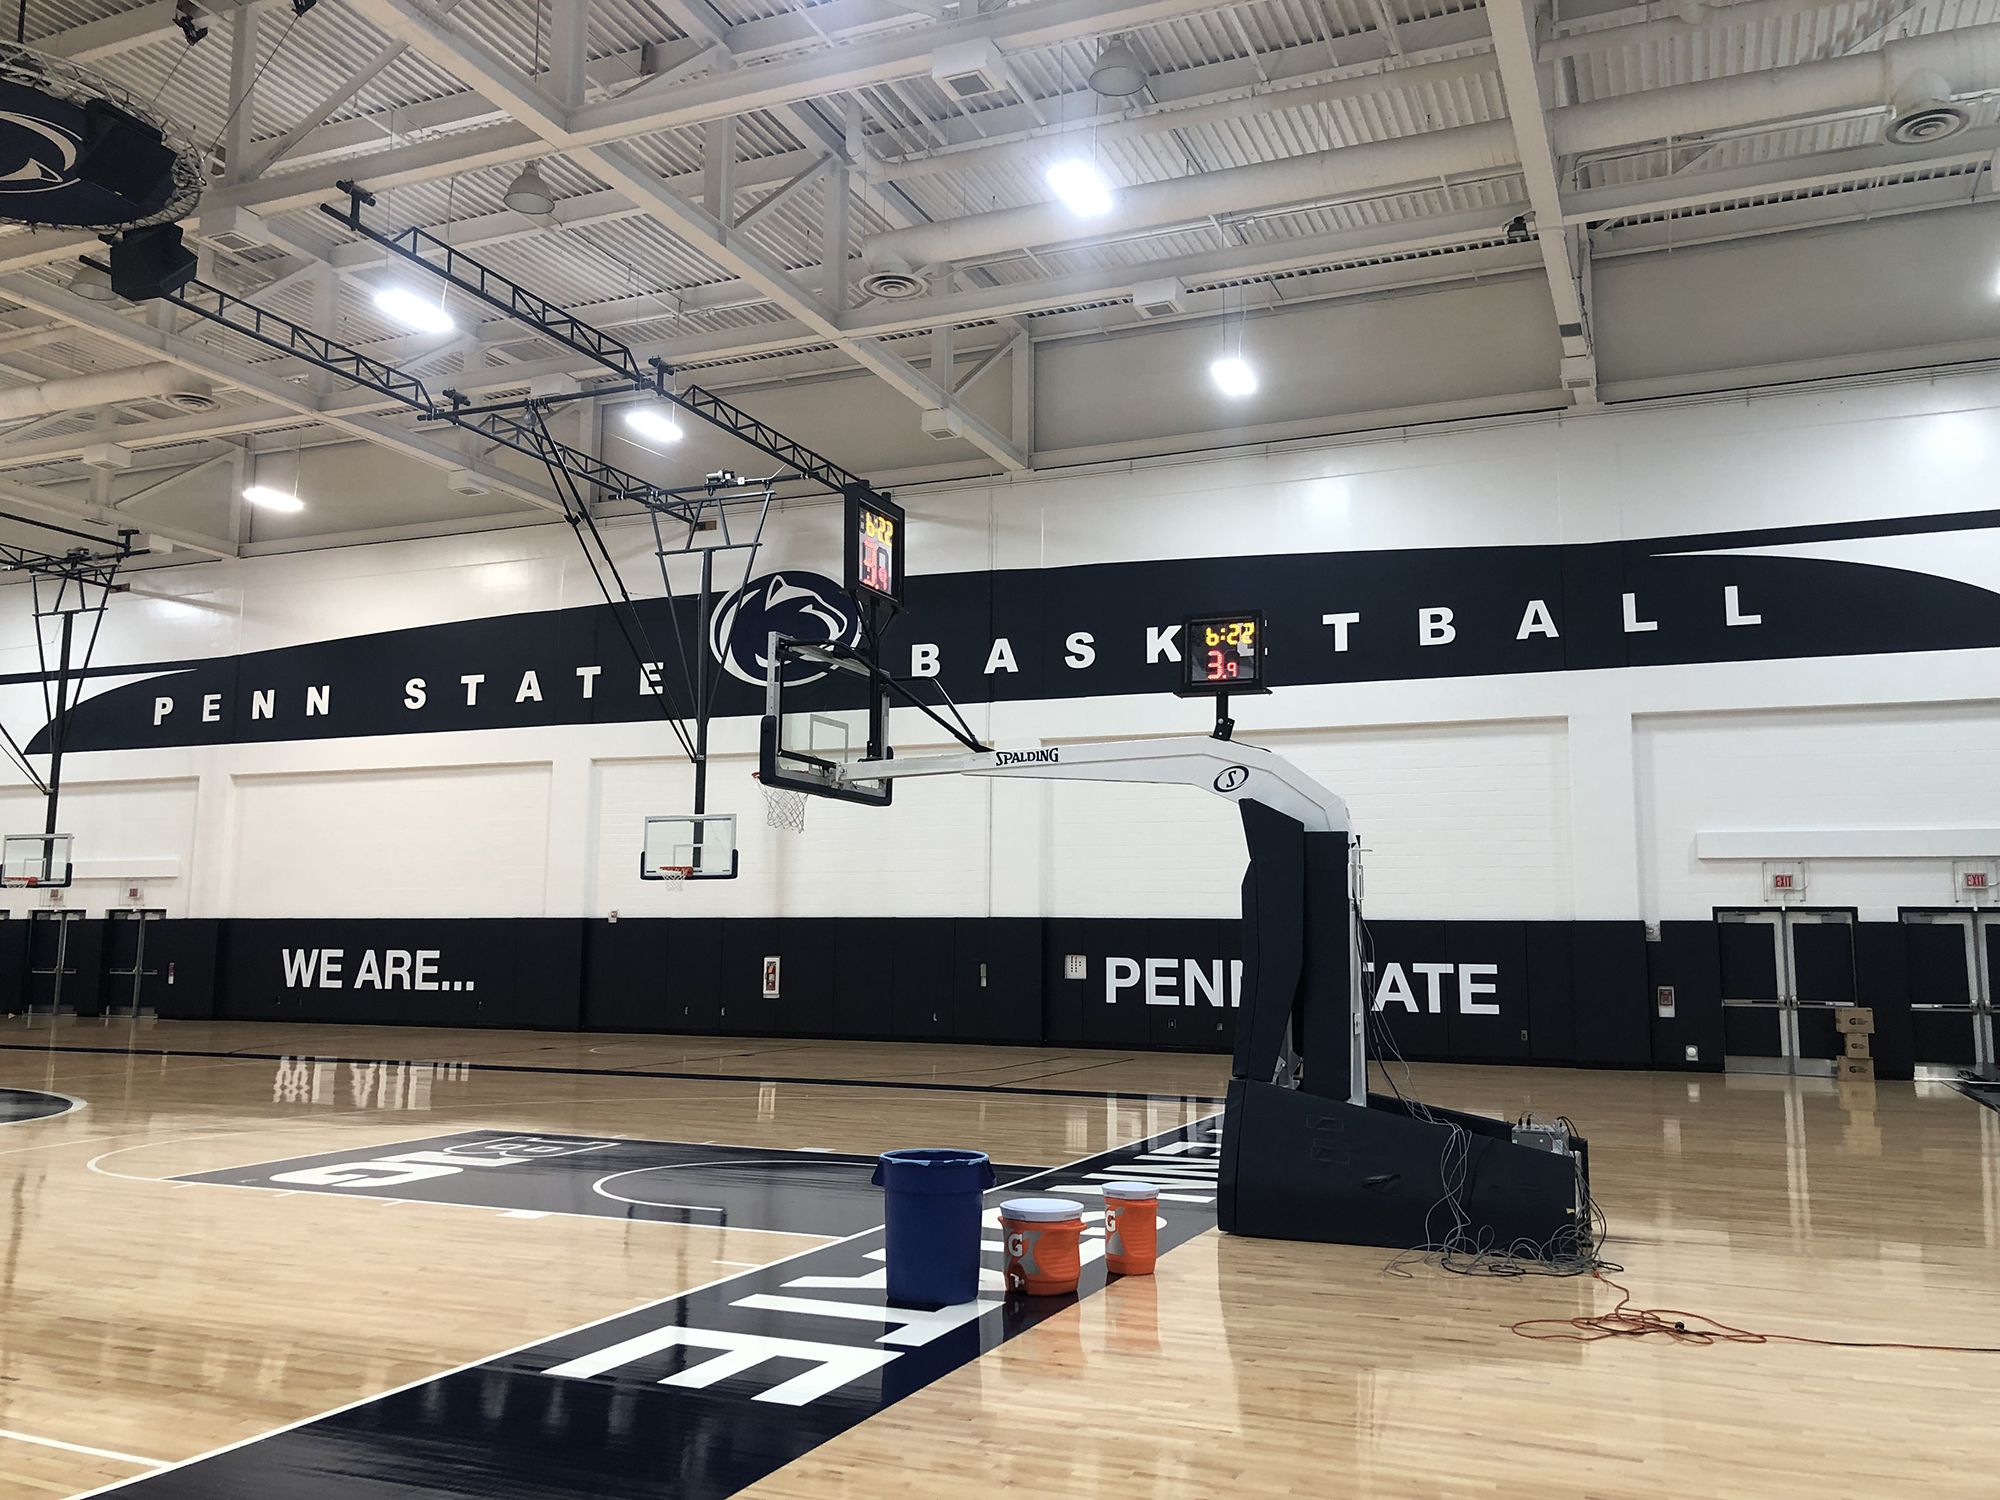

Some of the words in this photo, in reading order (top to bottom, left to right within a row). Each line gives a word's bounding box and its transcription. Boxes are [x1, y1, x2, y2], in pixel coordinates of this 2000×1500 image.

[866, 512, 894, 548] 6:22
[1205, 622, 1255, 646] 6:22
[1207, 649, 1239, 680] 3.9
[153, 685, 330, 726] PENN
[403, 662, 665, 710] STATE
[995, 747, 1059, 767] SPALDING
[1774, 874, 1793, 888] EXIT
[1966, 874, 1986, 887] EXIT
[281, 948, 345, 989] WE
[353, 949, 475, 992] ARE...
[1362, 962, 1501, 1015] ATE
[1104, 1209, 1117, 1232] G
[1007, 1232, 1024, 1257] G
